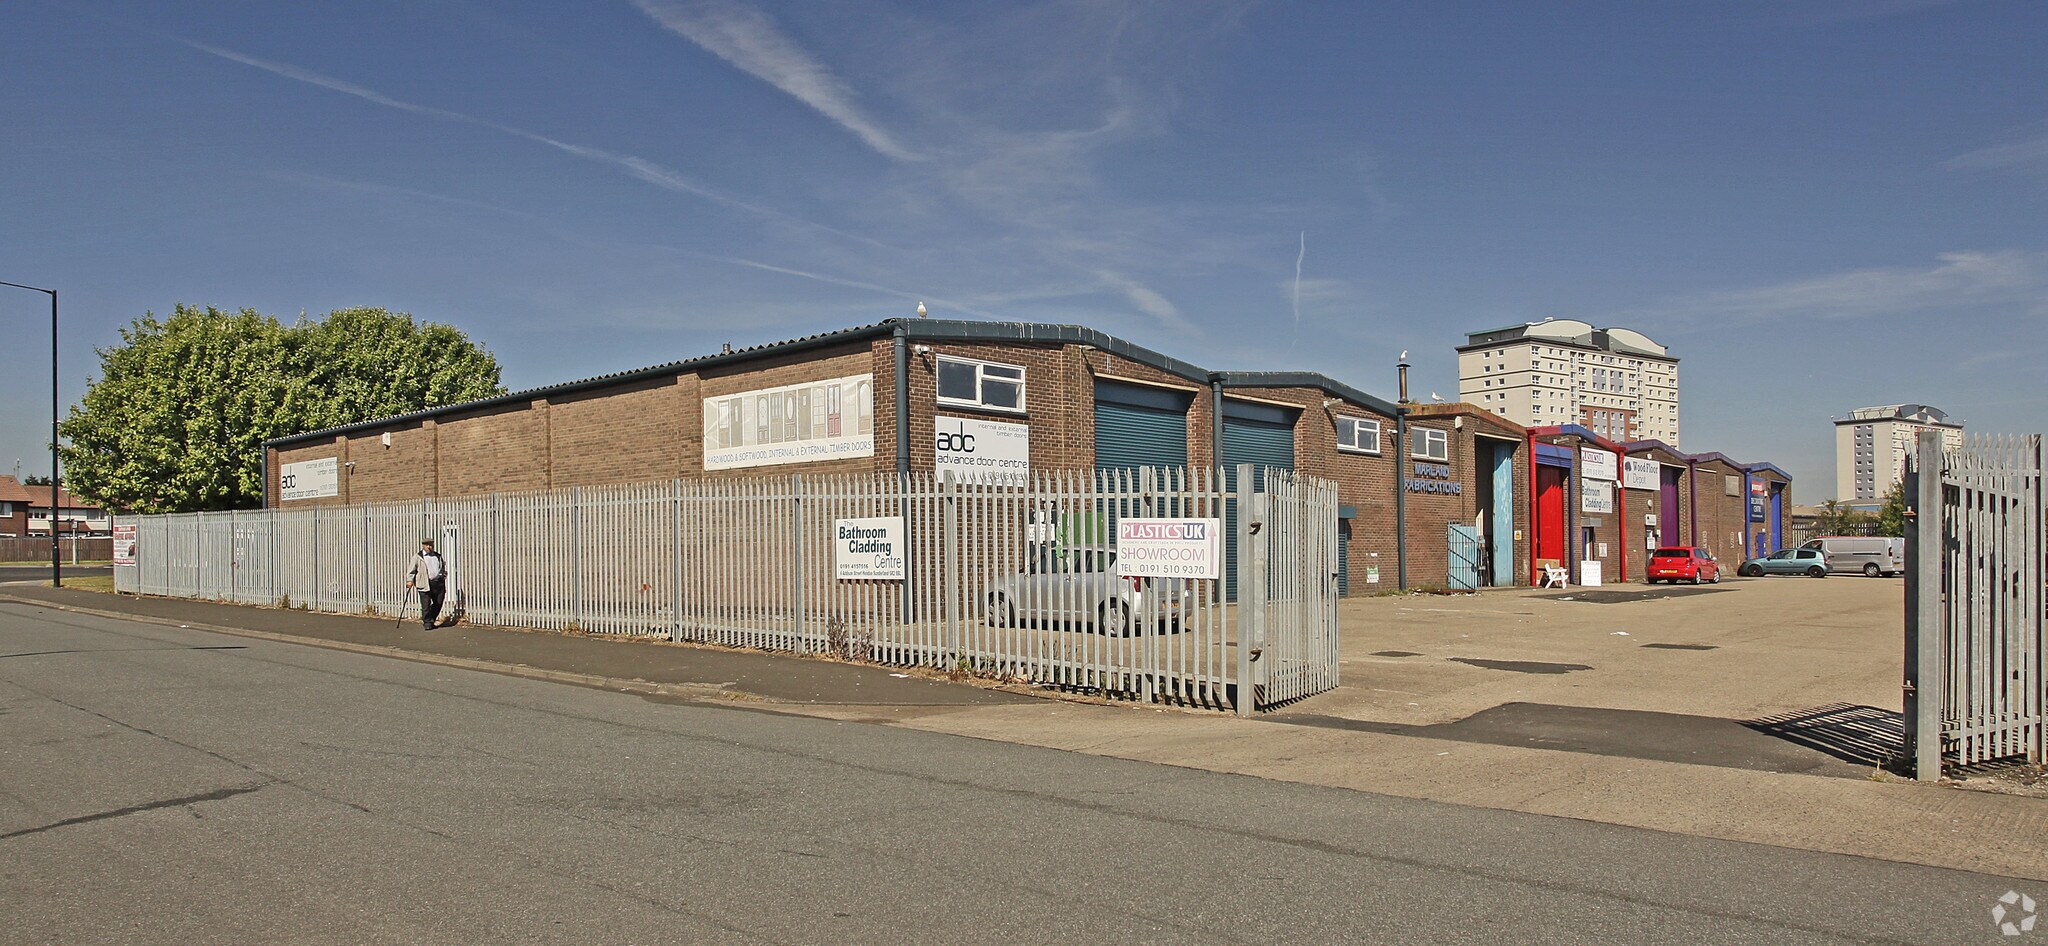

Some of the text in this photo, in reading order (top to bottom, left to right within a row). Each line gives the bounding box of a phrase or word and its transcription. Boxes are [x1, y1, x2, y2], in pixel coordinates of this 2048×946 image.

[937, 421, 975, 453] adc
[706, 454, 734, 464] HARDWOOD
[769, 448, 795, 458] INTERNAL
[800, 446, 828, 456] EXTERNAL
[829, 443, 850, 453] TIMBER
[851, 441, 872, 451] DOORS
[937, 454, 1028, 469] advance door centre
[1414, 463, 1449, 478] MARLAND
[1404, 479, 1461, 495] FABRICATIONS
[839, 526, 887, 540] Bathroom
[849, 539, 892, 556] Cladding
[1120, 547, 1205, 561] SHOWROOM
[874, 554, 902, 569] Centre
[1121, 563, 1132, 573] TEL
[1139, 564, 1160, 573] 0191
[1163, 565, 1180, 574] 510
[1182, 565, 1205, 575] 9370
